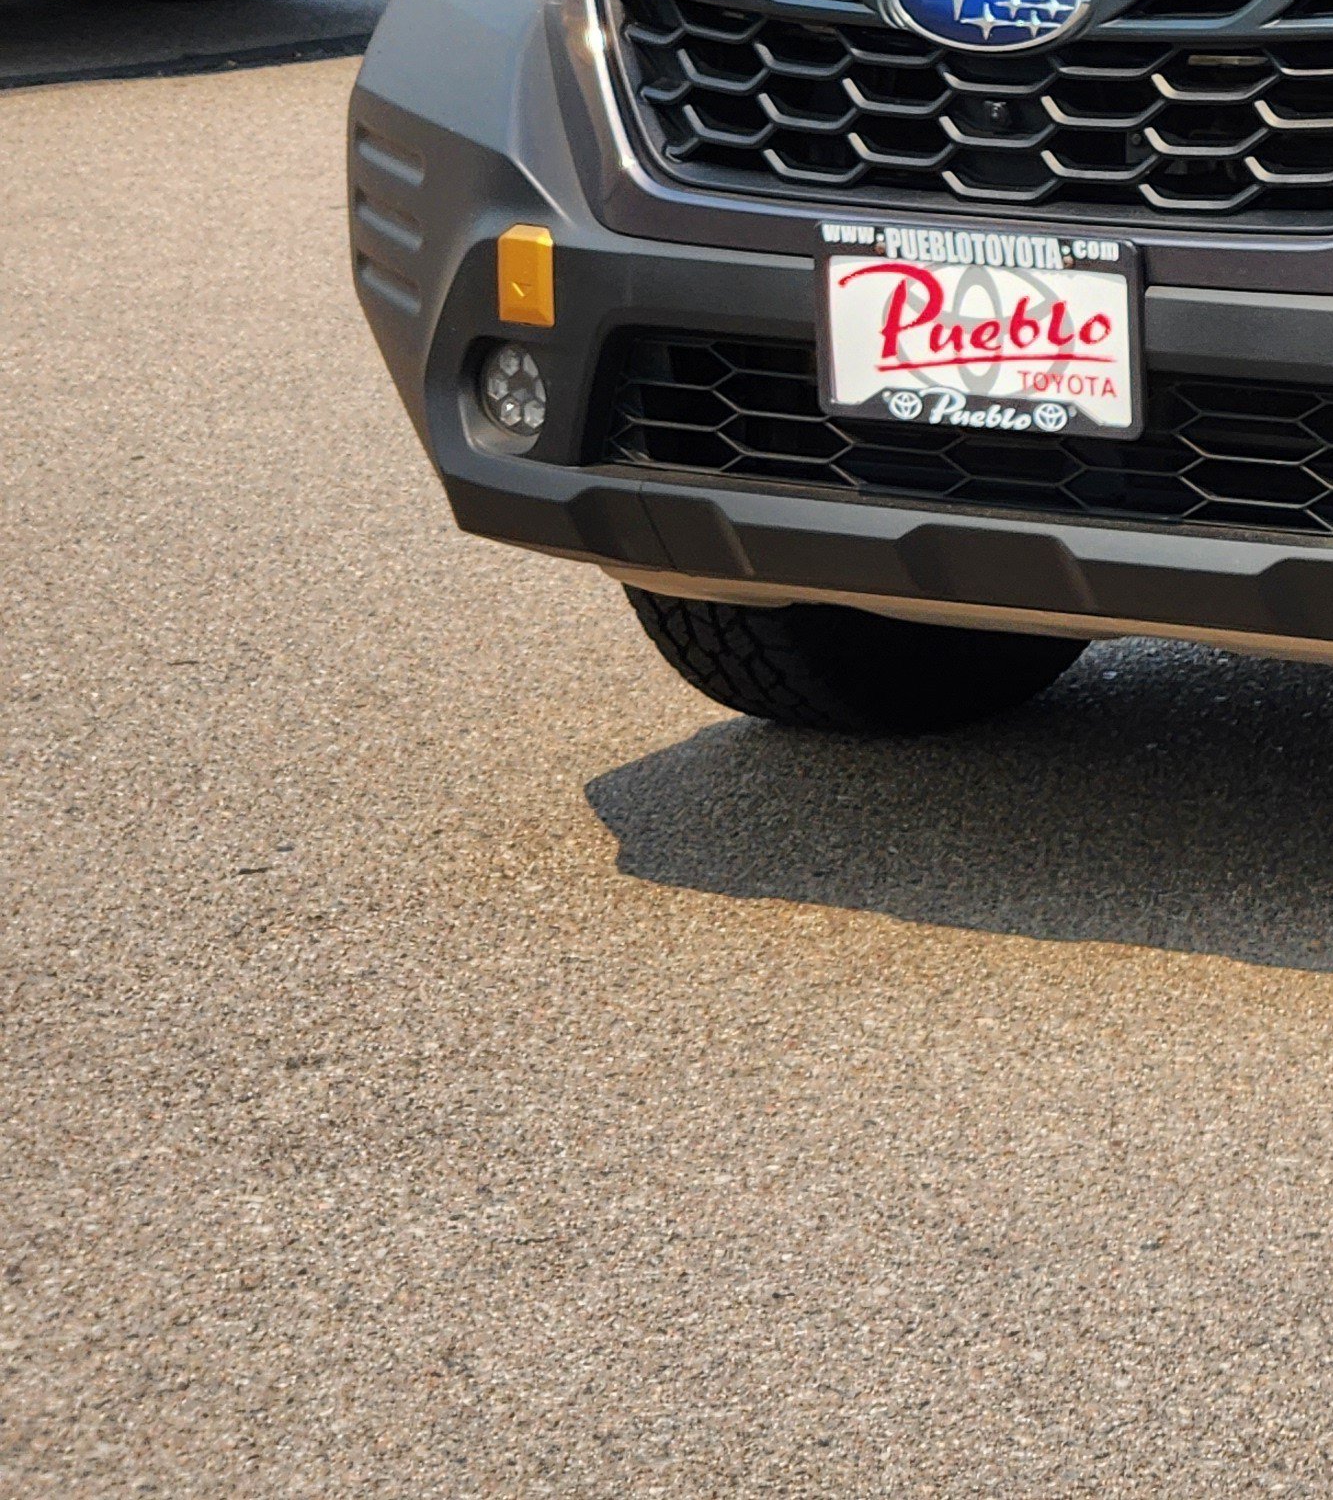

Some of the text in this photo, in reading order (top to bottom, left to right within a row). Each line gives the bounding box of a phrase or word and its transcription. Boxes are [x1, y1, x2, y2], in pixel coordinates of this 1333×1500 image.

[838, 262, 1112, 360] Pueblo
[1017, 369, 1117, 398] TOYOTA
[920, 385, 1032, 431] Pueblo
